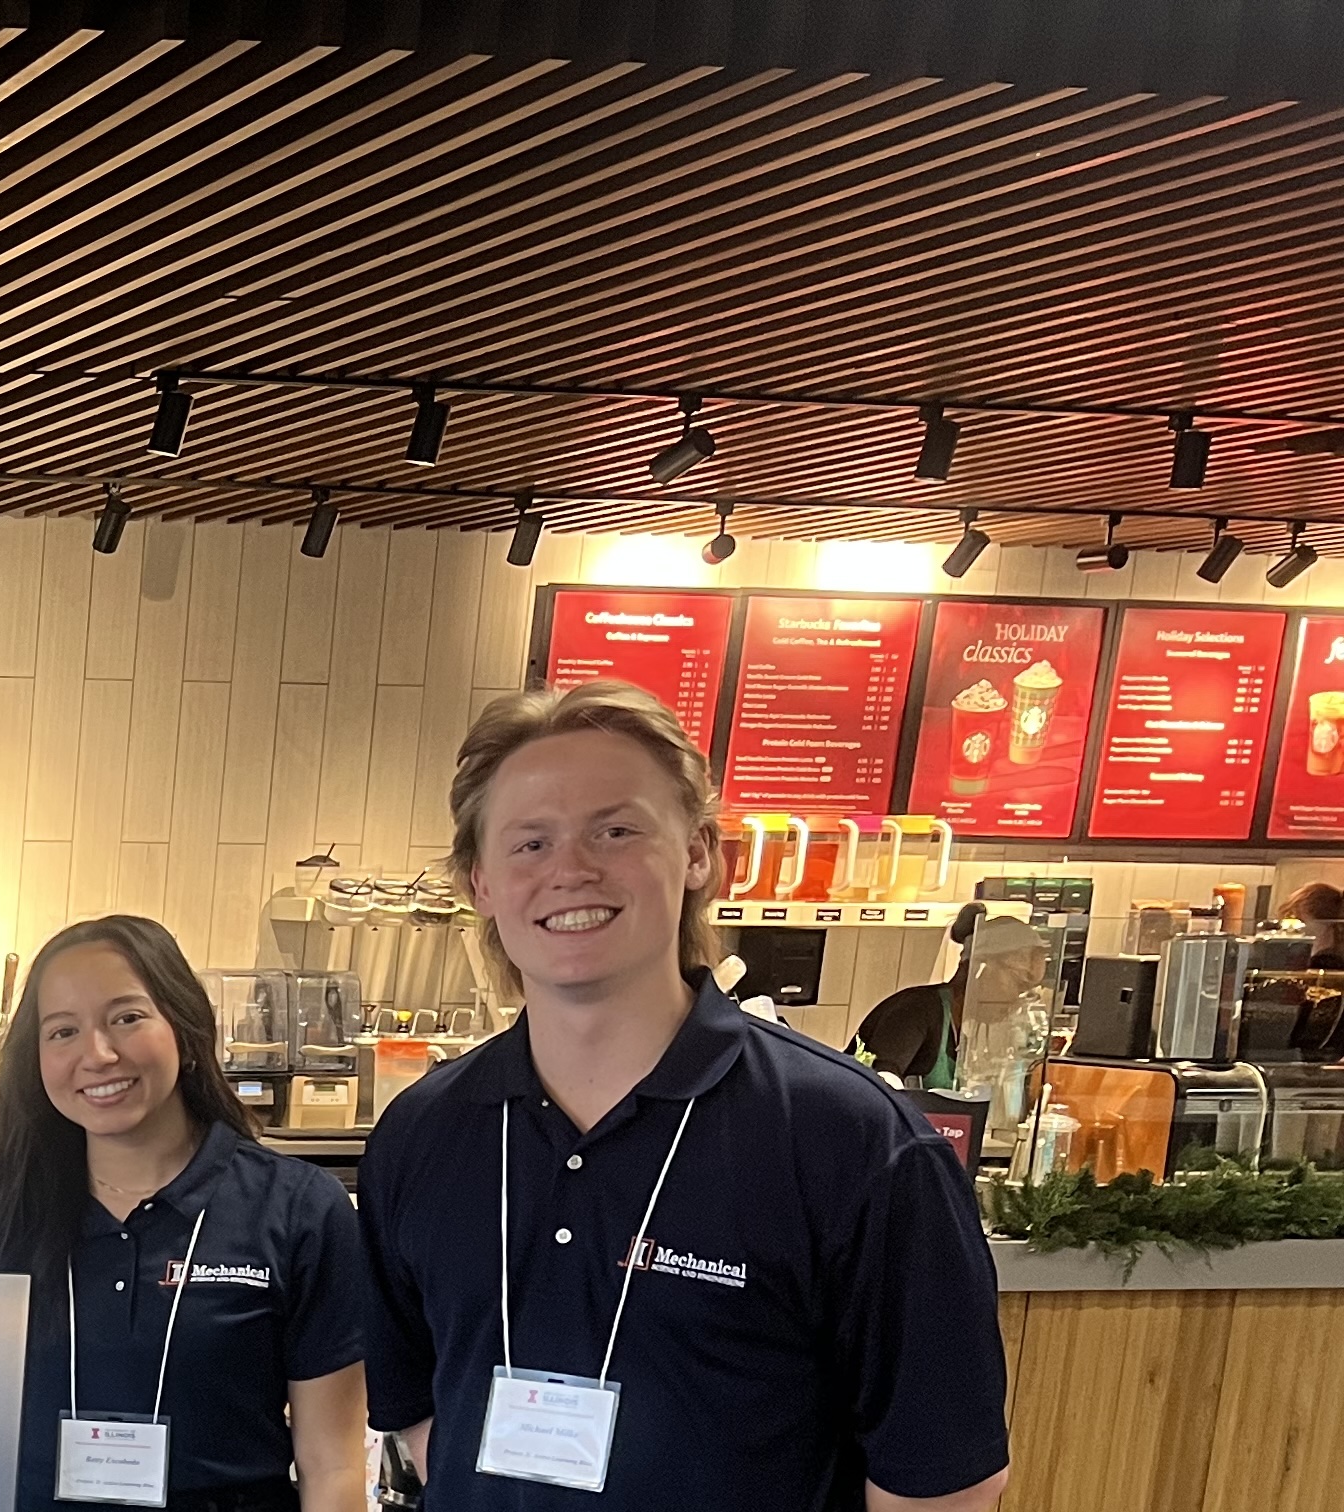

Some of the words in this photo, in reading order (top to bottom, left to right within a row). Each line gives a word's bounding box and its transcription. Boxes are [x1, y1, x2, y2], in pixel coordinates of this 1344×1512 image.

[995, 623, 1069, 641] HOLIDAY
[1156, 630, 1194, 644] Holiday
[1194, 631, 1244, 643] Selections
[963, 640, 1033, 663] classics
[943, 1127, 964, 1138] Tap
[654, 1246, 746, 1279] Mechanical
[191, 1264, 270, 1281] Mechanical
